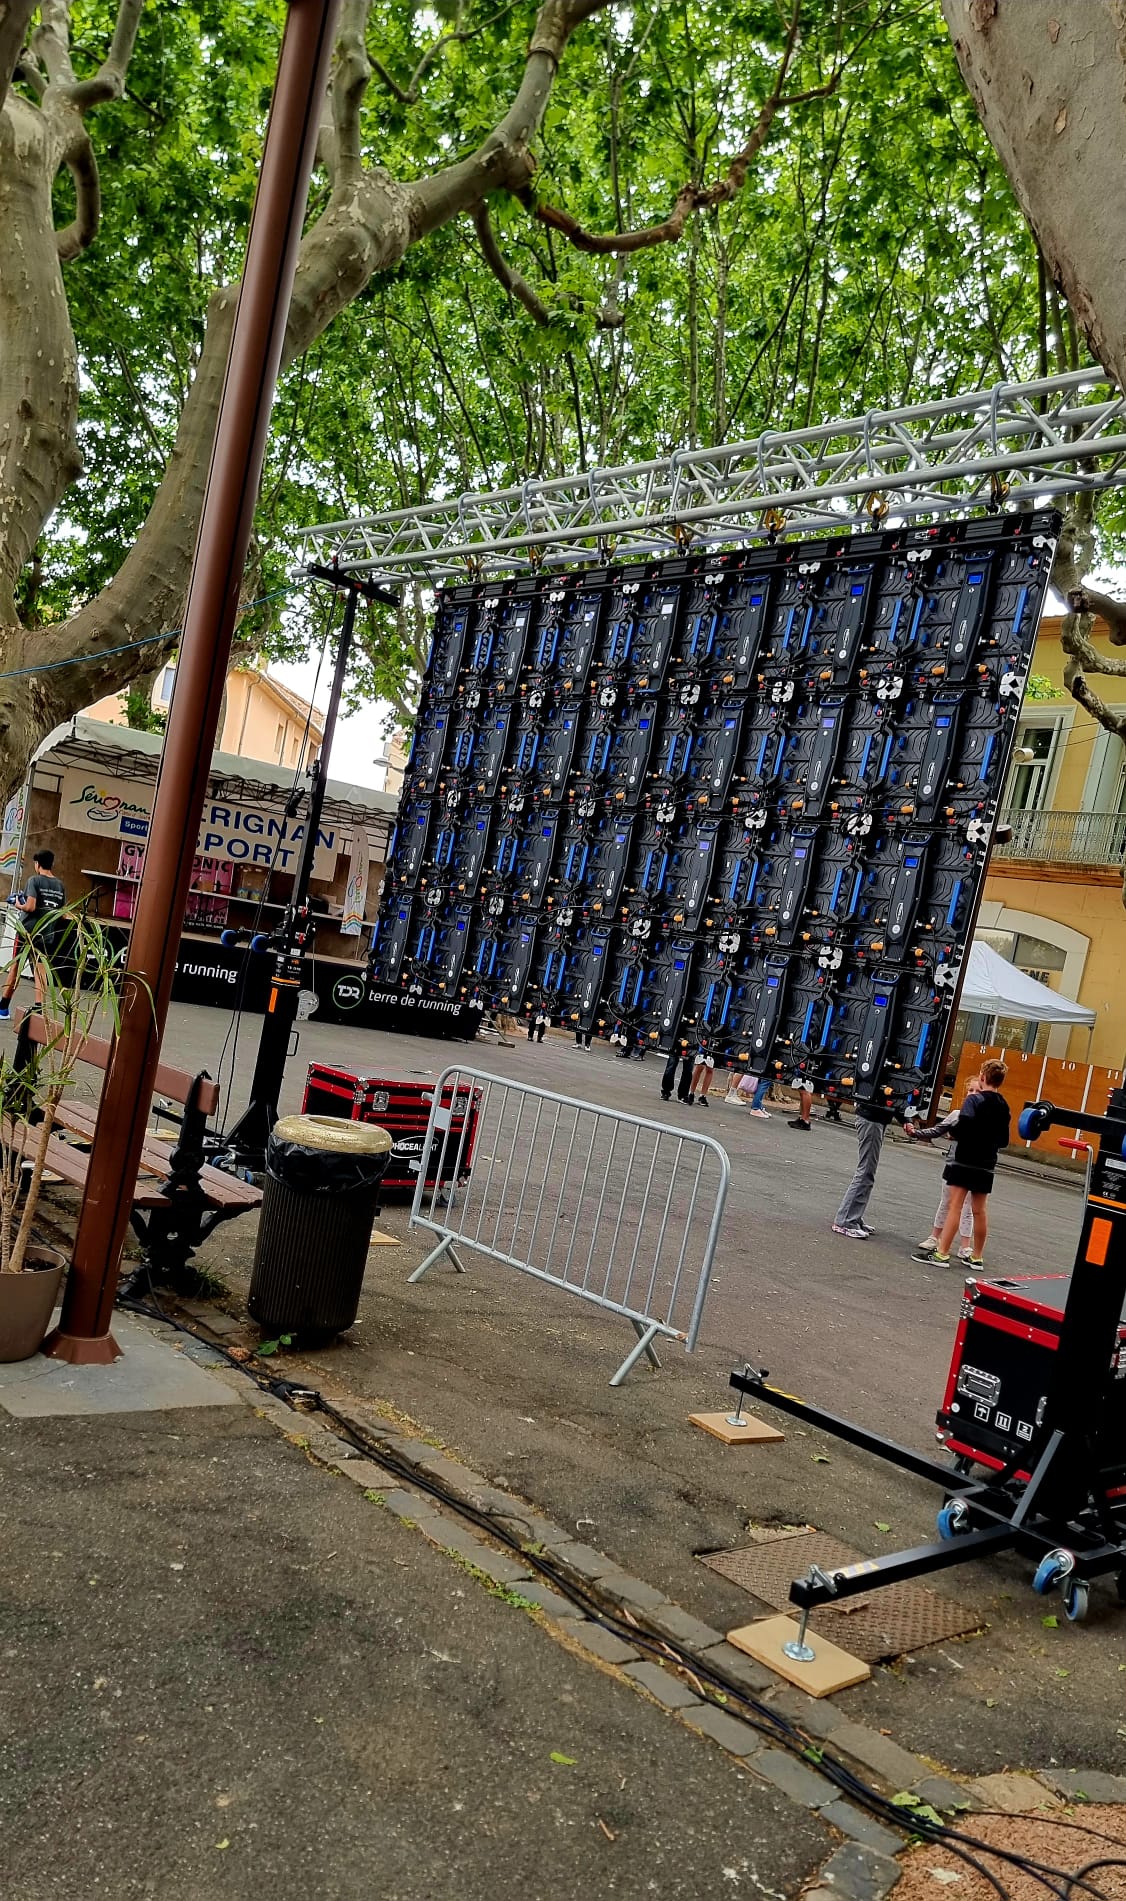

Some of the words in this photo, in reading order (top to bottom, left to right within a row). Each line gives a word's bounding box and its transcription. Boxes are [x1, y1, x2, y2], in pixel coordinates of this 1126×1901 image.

[182, 963, 238, 984] running
[368, 989, 398, 1004] terre
[400, 994, 416, 1007] de
[418, 998, 462, 1016] running
[979, 1045, 987, 1055] 8
[1021, 1053, 1028, 1062] 9
[1061, 1060, 1076, 1071] 10
[1107, 1069, 1120, 1080] 11
